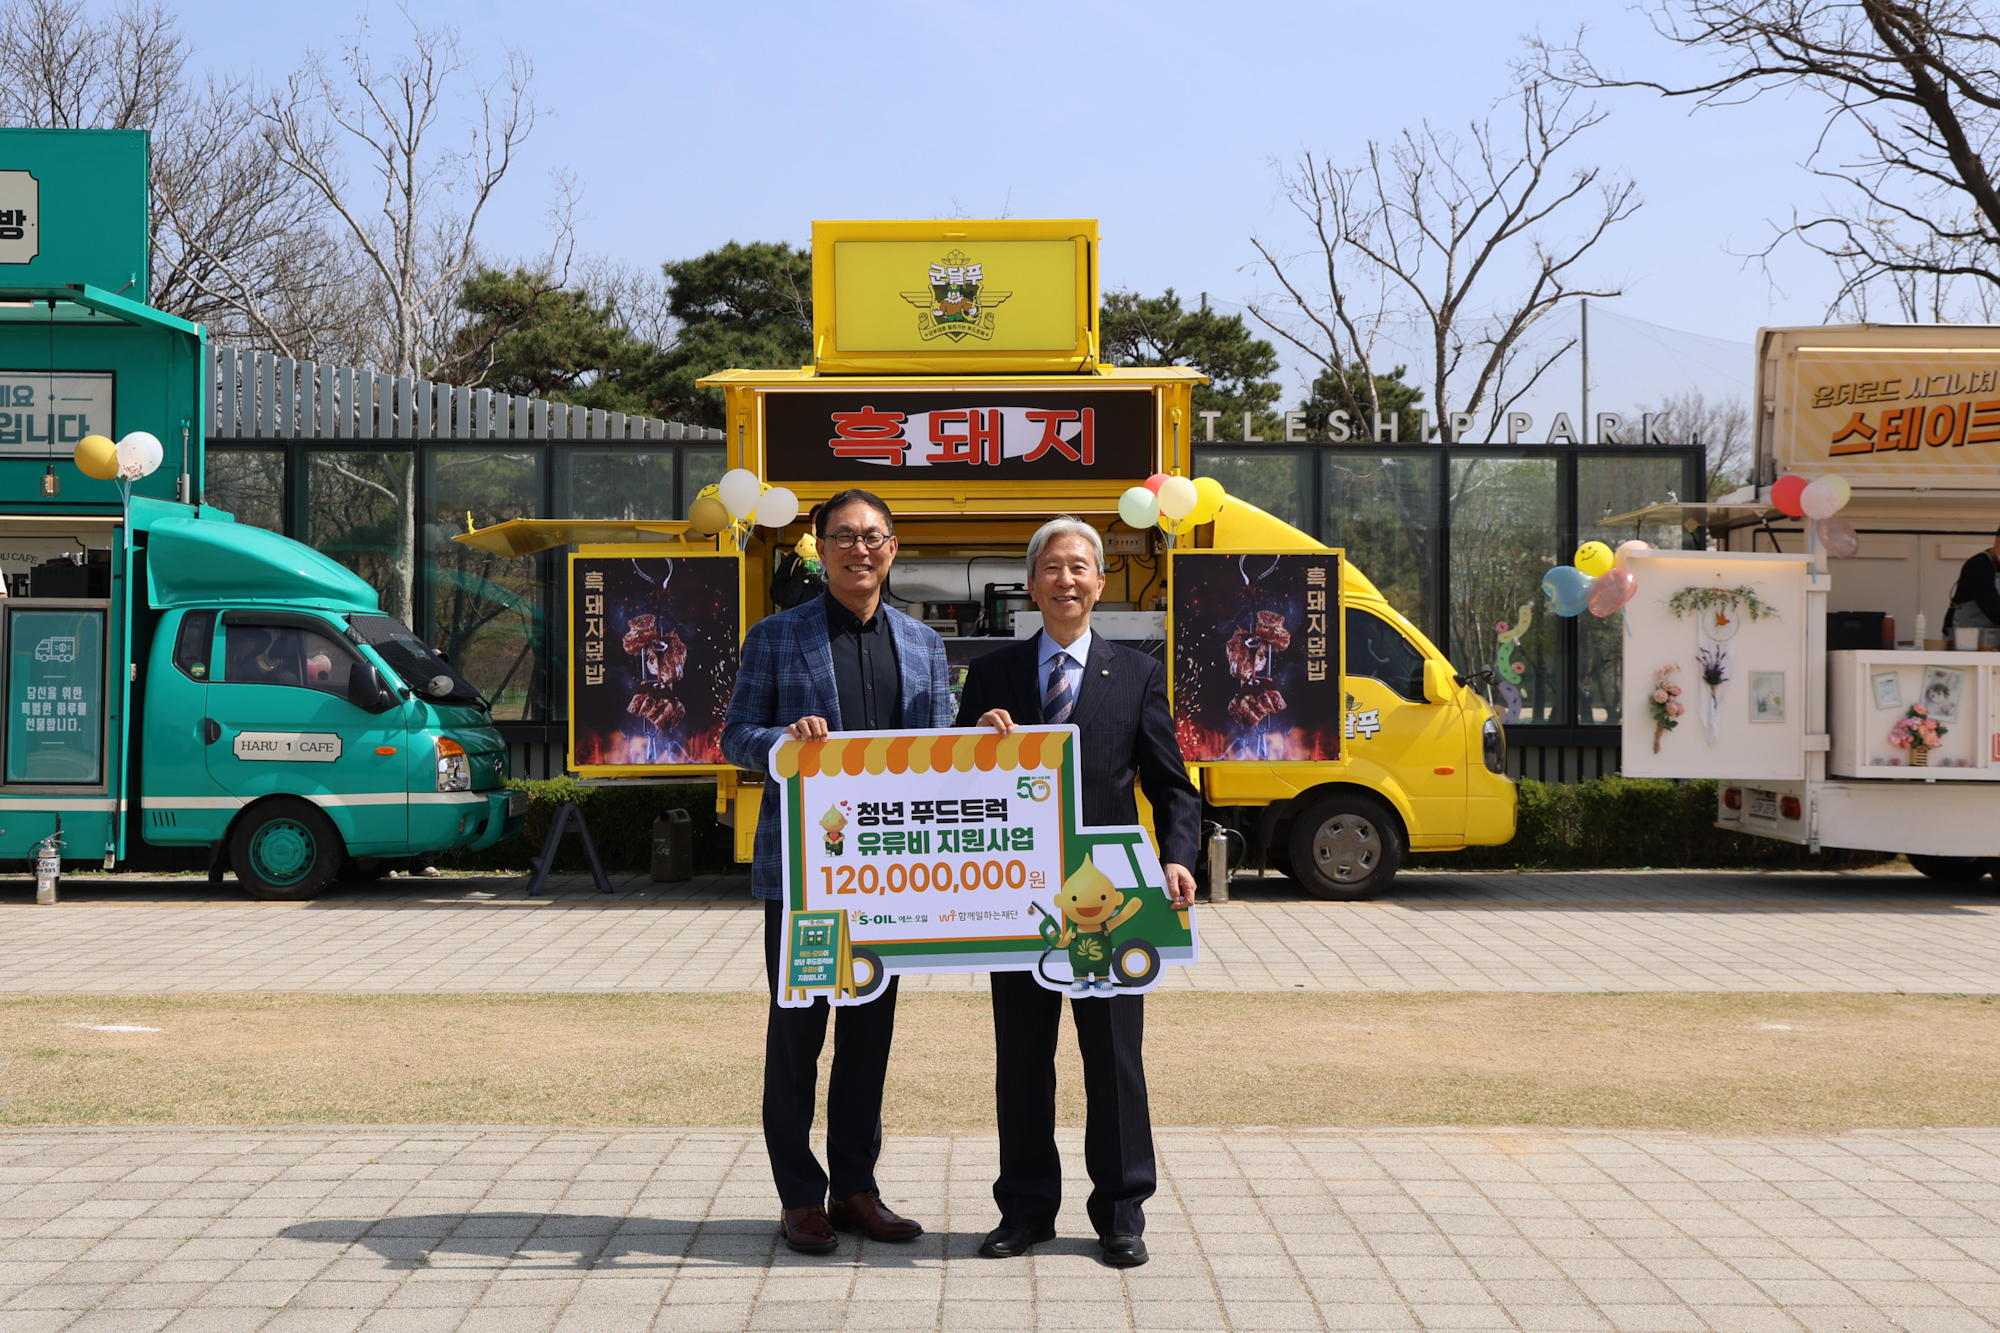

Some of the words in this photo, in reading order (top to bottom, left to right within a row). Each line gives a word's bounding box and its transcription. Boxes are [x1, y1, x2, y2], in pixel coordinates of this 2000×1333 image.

[928, 262, 983, 286] 군달푸
[1811, 379, 1902, 409] 온더로드
[828, 405, 1095, 467] 흑돼지
[1507, 411, 1669, 445] PARK
[11, 552, 39, 565] CAFE
[584, 571, 606, 686] 흑돼지덮밥
[1306, 566, 1328, 682] 흑돼지덮밥
[26, 686, 57, 700] 당신을
[61, 686, 83, 700] 위한
[21, 702, 52, 716] 특별한
[56, 702, 87, 716] 하루를
[26, 718, 82, 732] 선물합니다.
[241, 740, 278, 751] HARU
[286, 742, 292, 751] 1
[300, 742, 334, 753] CAFE
[857, 801, 905, 826] 청년
[910, 798, 1008, 825] 푸드트럭
[857, 830, 930, 856] 유류비
[936, 827, 1034, 854] 지원사업
[858, 914, 897, 926] S-OIL
[957, 910, 1019, 922] 함께일하는재단
